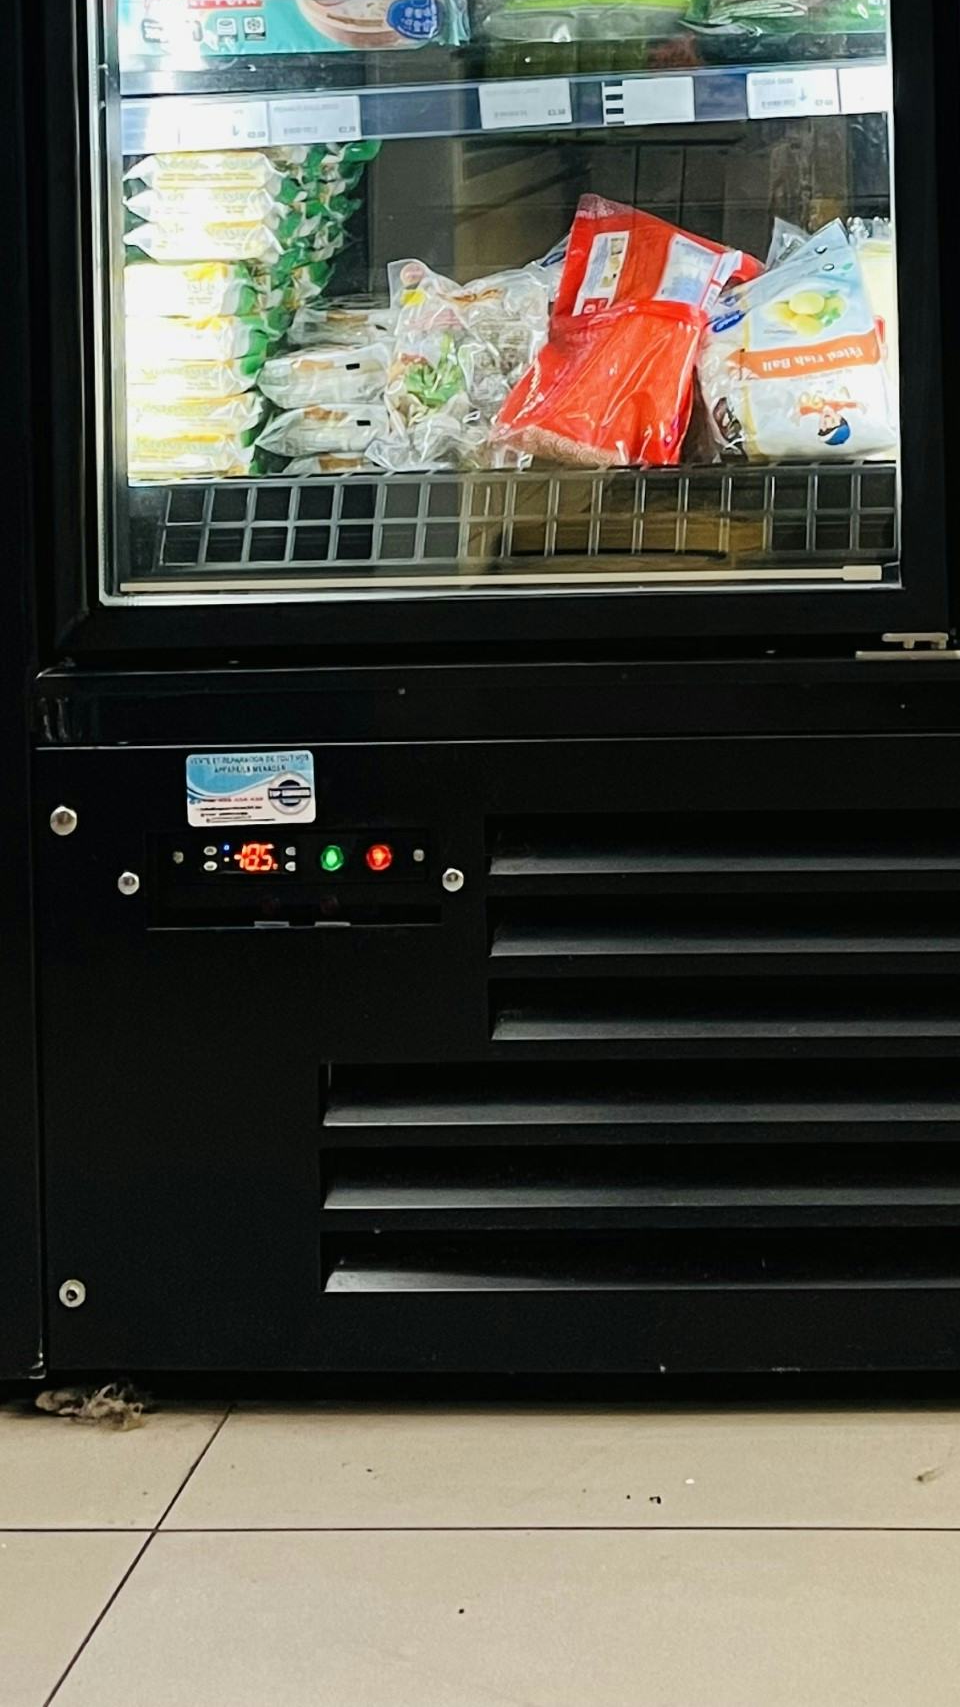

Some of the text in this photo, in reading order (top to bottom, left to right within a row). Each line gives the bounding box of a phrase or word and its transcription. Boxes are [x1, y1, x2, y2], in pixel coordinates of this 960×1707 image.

[762, 346, 864, 372] Fried Fish Ball
